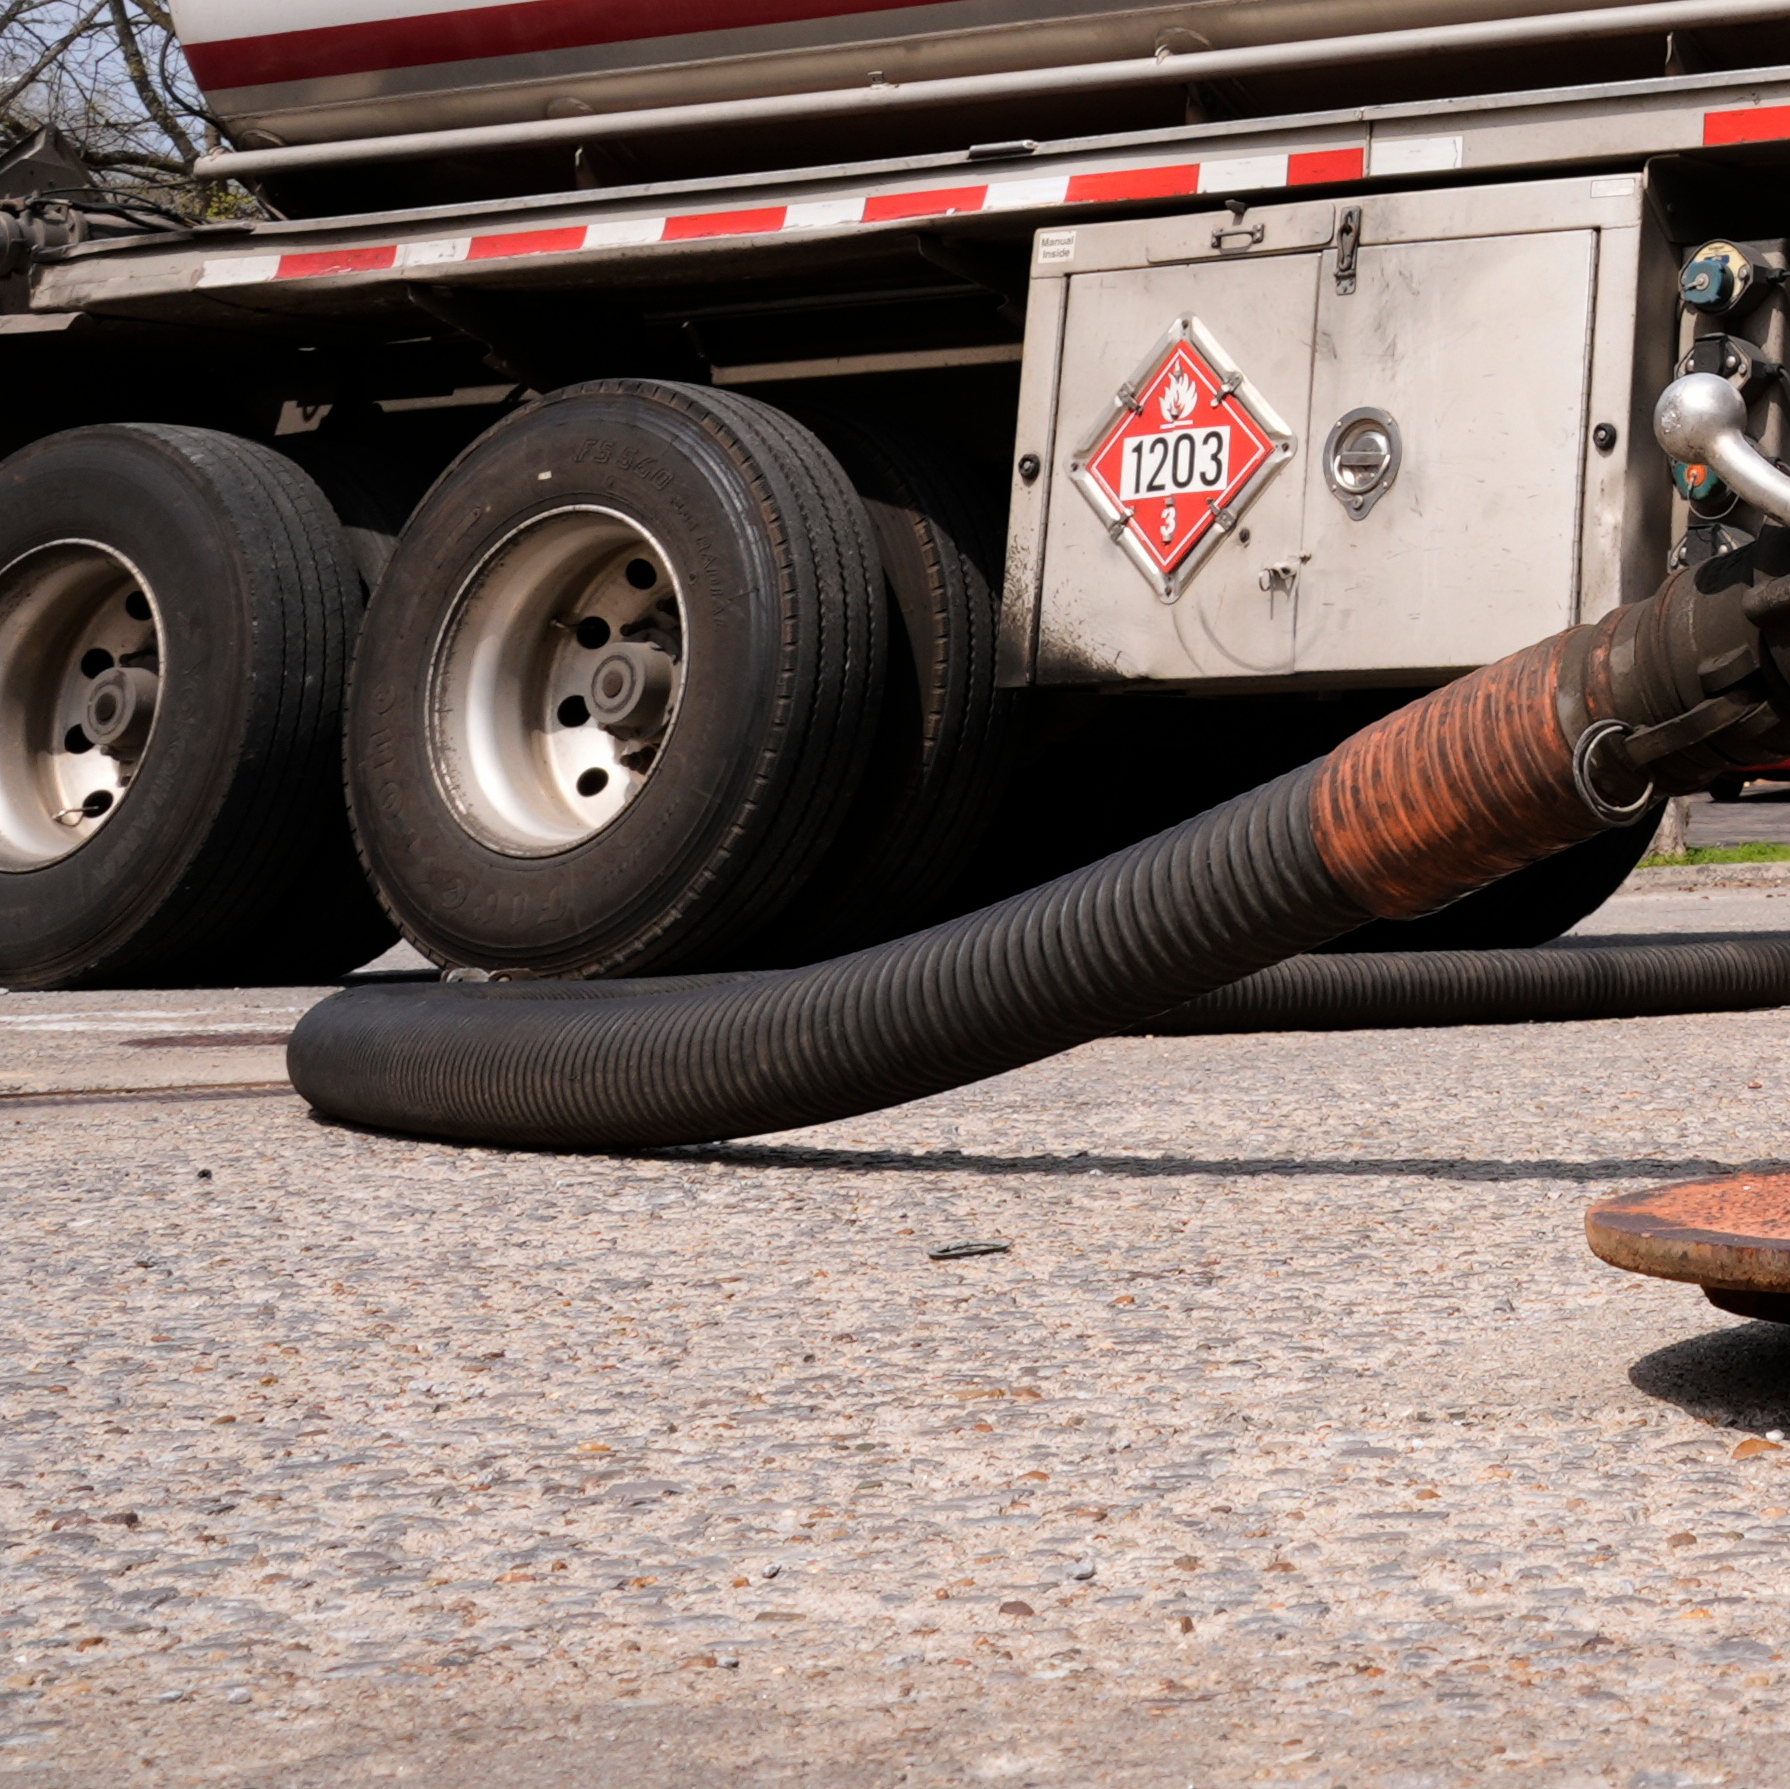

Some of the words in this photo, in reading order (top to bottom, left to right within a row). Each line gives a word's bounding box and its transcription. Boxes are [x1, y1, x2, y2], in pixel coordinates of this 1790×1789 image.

[1041, 236, 1074, 247] Manual
[1042, 248, 1071, 259] Inside
[1131, 431, 1223, 494] 1203
[1160, 506, 1176, 536] 3
